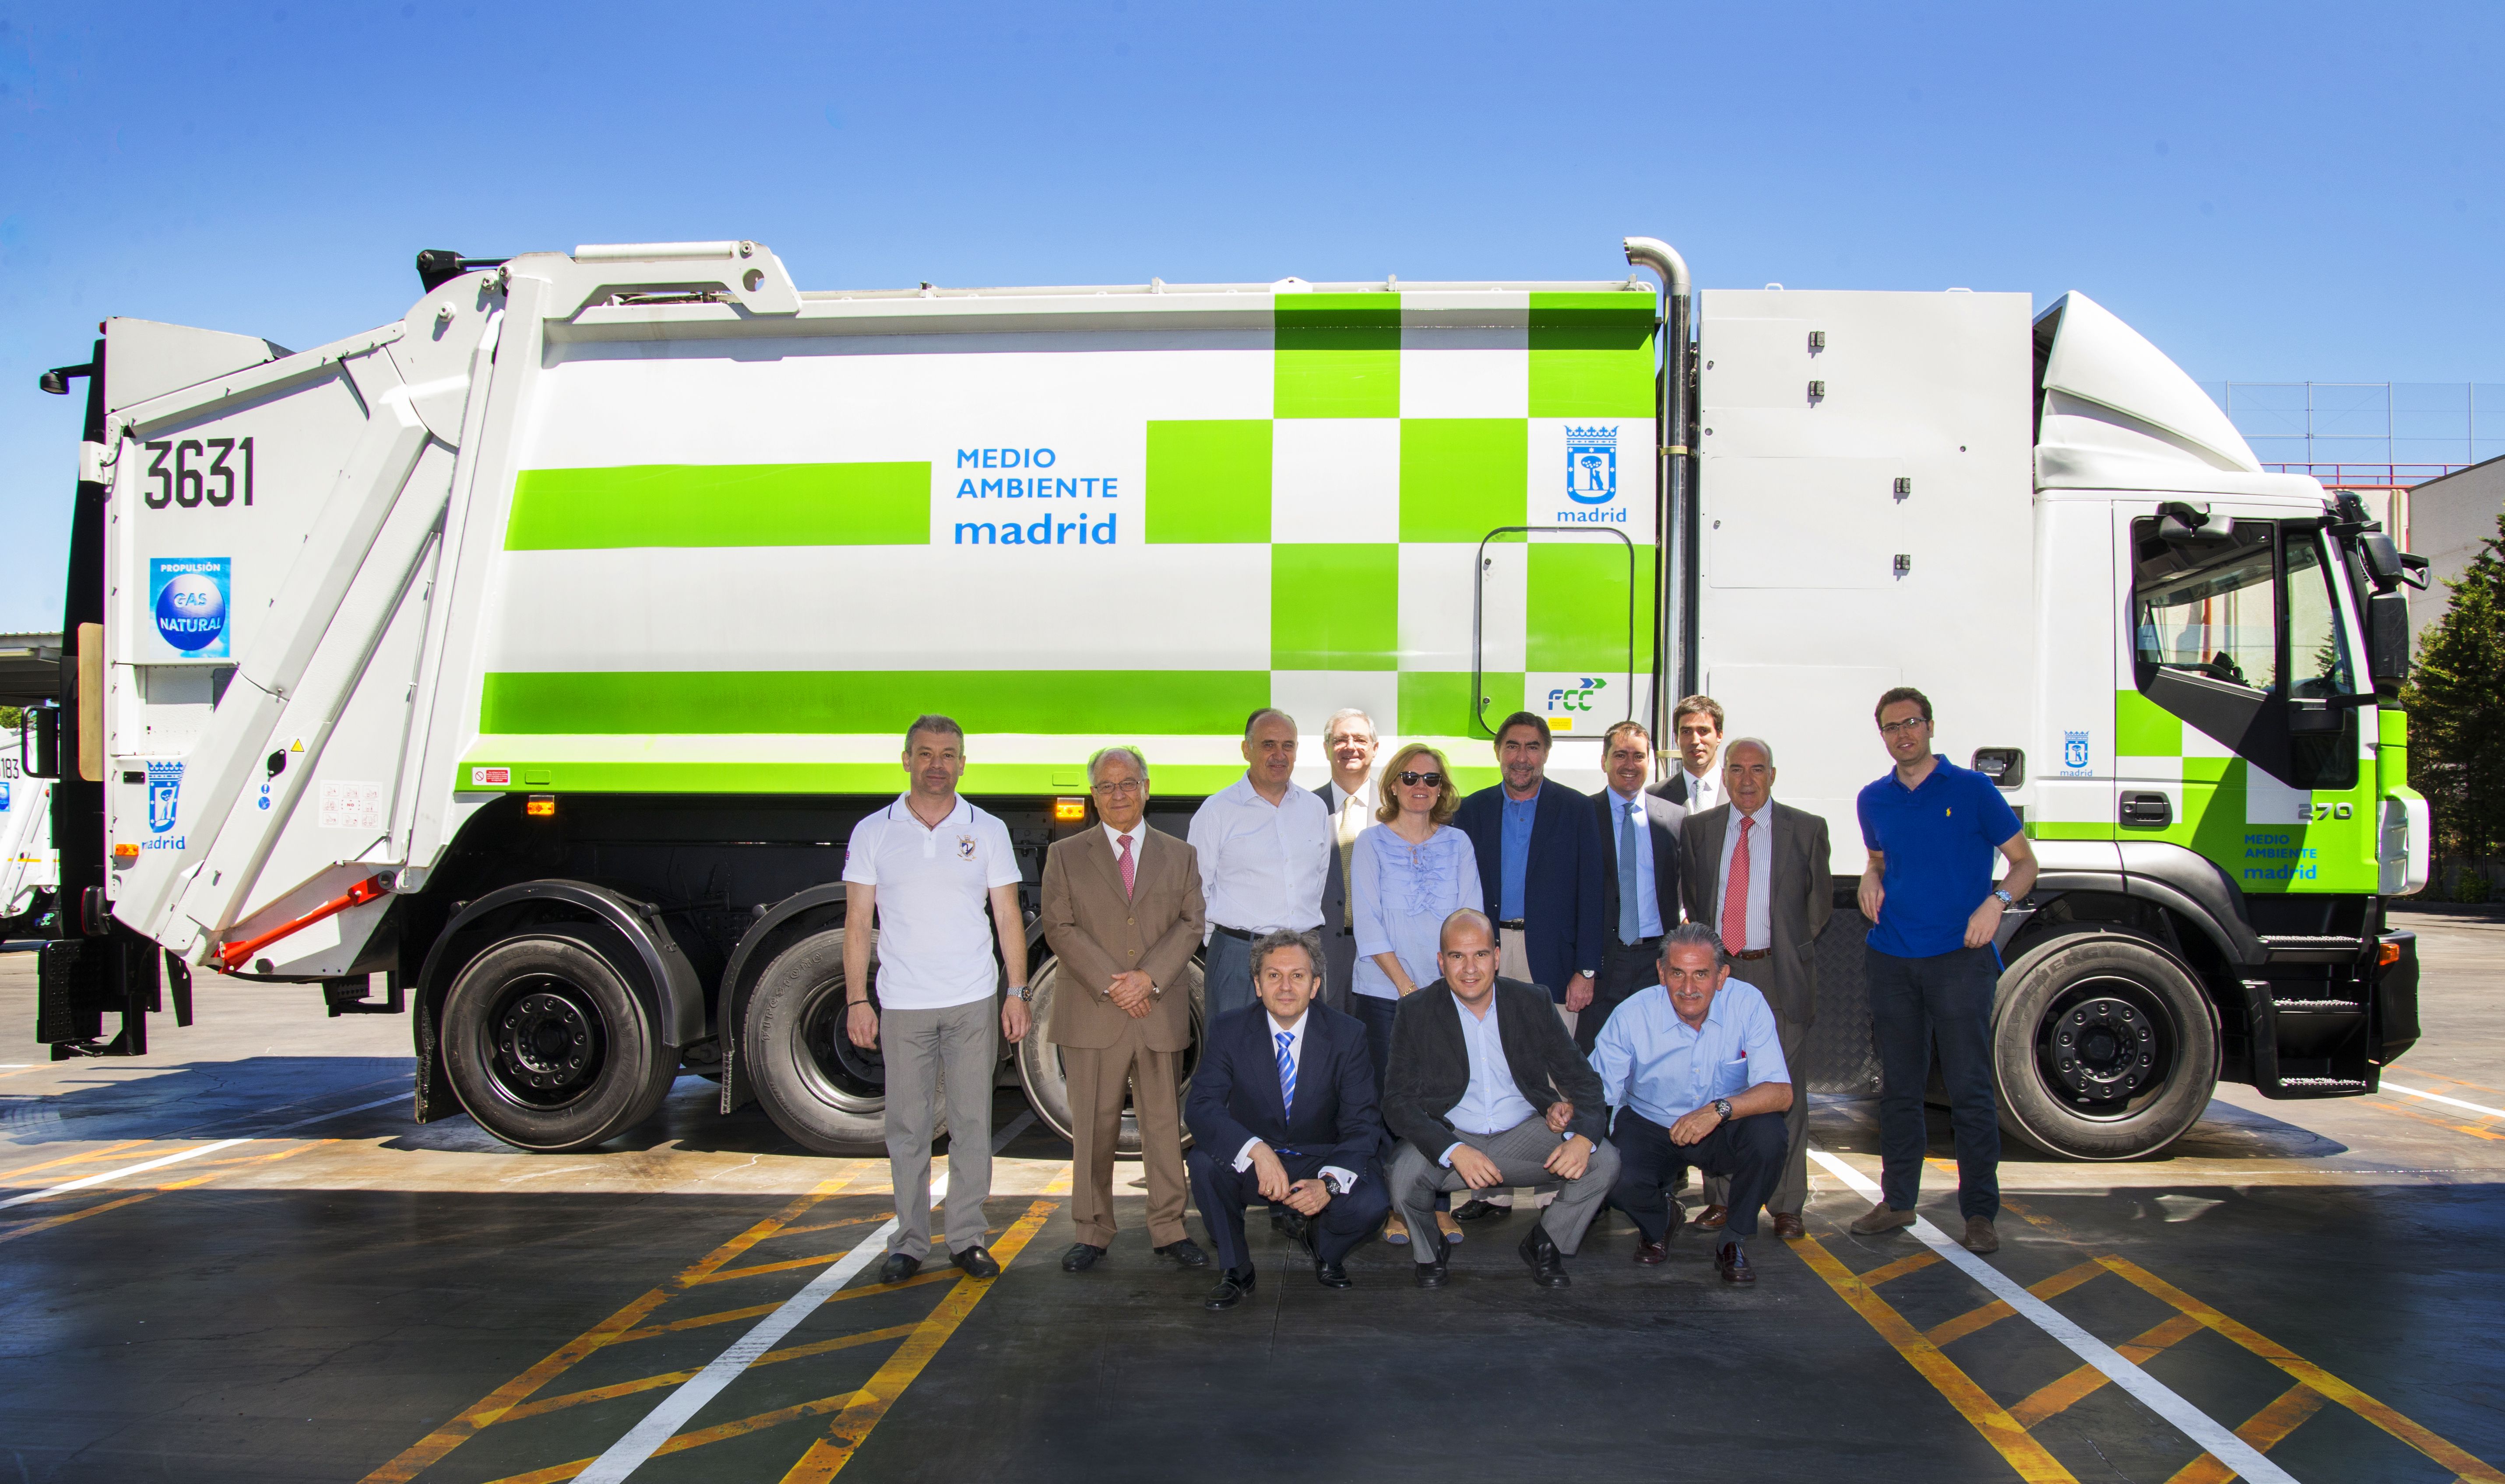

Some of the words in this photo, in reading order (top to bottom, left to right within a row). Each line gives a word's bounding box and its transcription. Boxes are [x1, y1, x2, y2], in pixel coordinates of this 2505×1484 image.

[957, 448, 1056, 468] MEDIO
[145, 437, 253, 509] 3631
[957, 478, 1118, 498] AMBIENTE
[1558, 508, 1627, 522] madrid
[955, 513, 1116, 545] madrid
[161, 562, 220, 572] PROPULSIÓN
[174, 593, 207, 607] GAS
[160, 617, 221, 632] NATURAL
[1548, 689, 1594, 711] FCC
[0, 758, 19, 779] 183
[2298, 802, 2353, 821] 270
[2245, 834, 2290, 844] MEDIO
[2245, 848, 2317, 858] AMBIENTE
[2244, 865, 2317, 879] madrid
[2020, 945, 2118, 1000] ENERGY
[2028, 1109, 2136, 1151] MICHELIN
